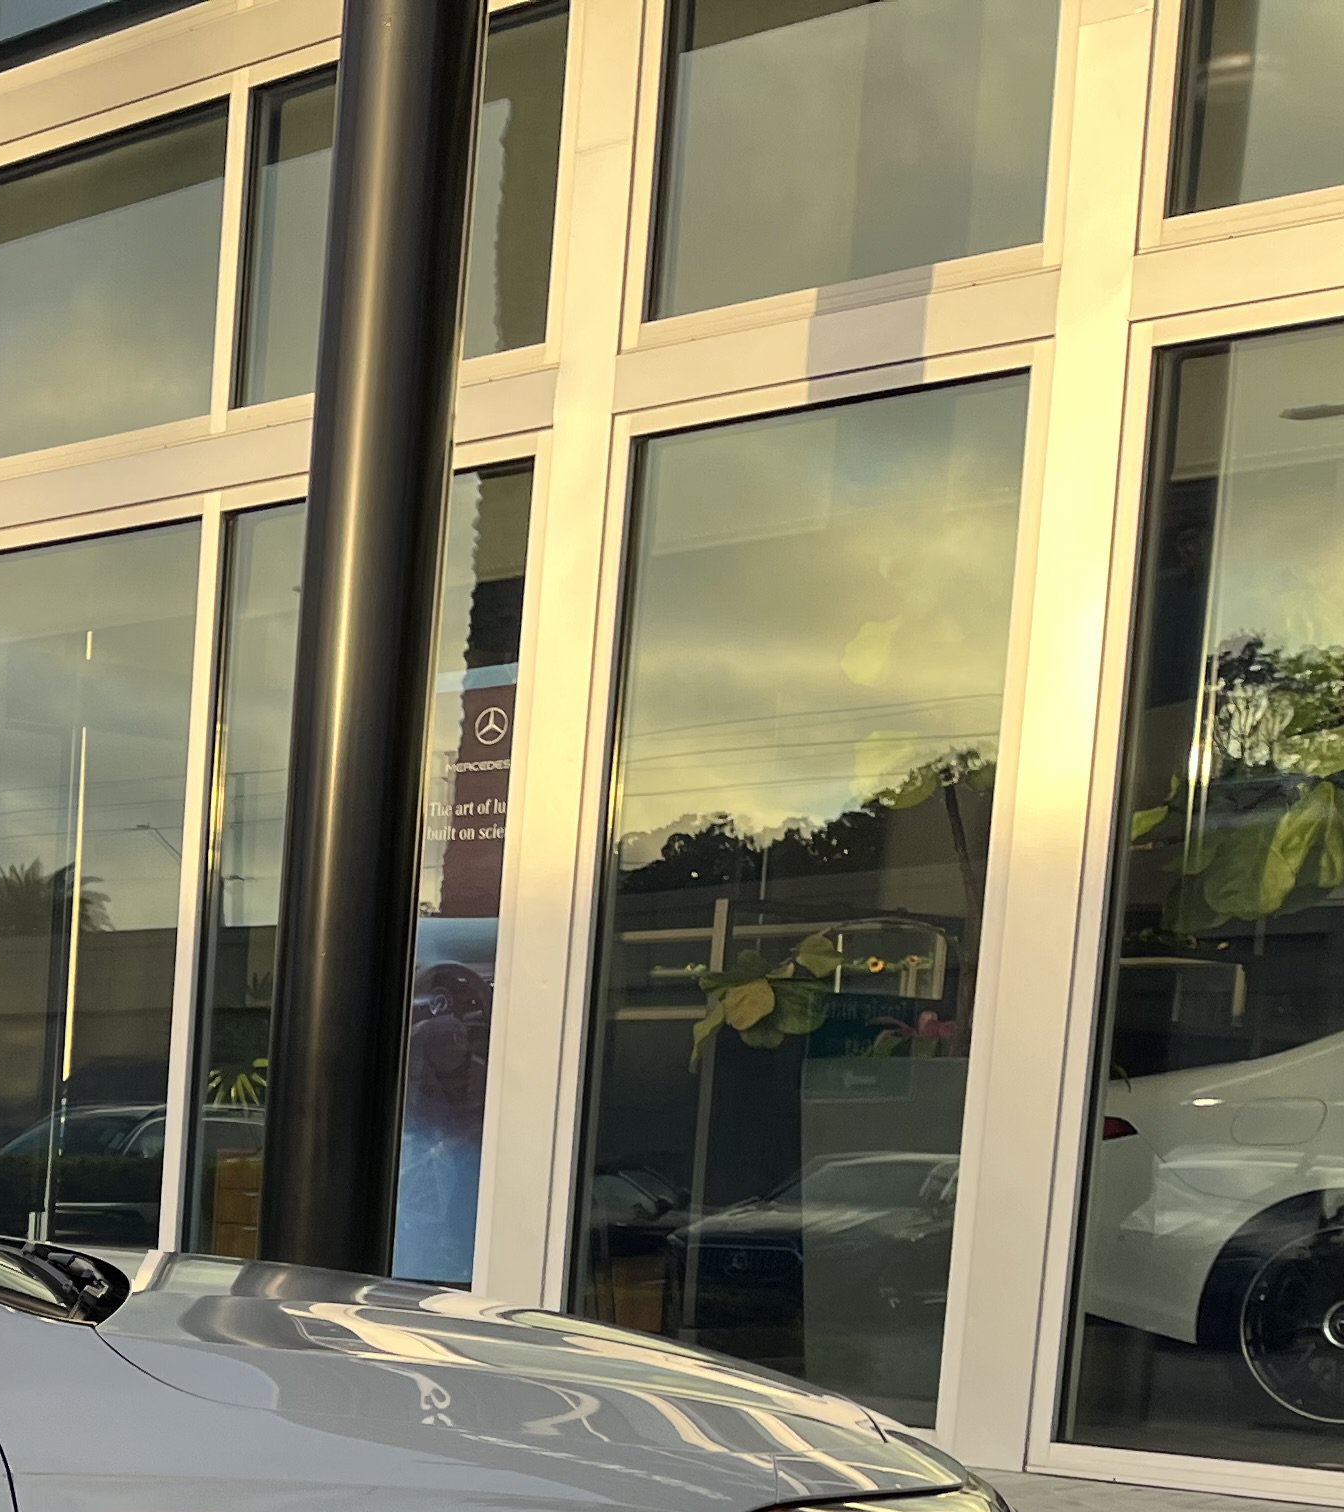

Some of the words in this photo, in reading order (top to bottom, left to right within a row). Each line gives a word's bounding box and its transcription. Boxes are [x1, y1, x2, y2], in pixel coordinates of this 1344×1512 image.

[430, 802, 452, 816] The
[455, 801, 474, 816] art
[477, 798, 492, 814] of
[493, 798, 507, 814] lu
[427, 825, 456, 841] built
[459, 828, 475, 840] on
